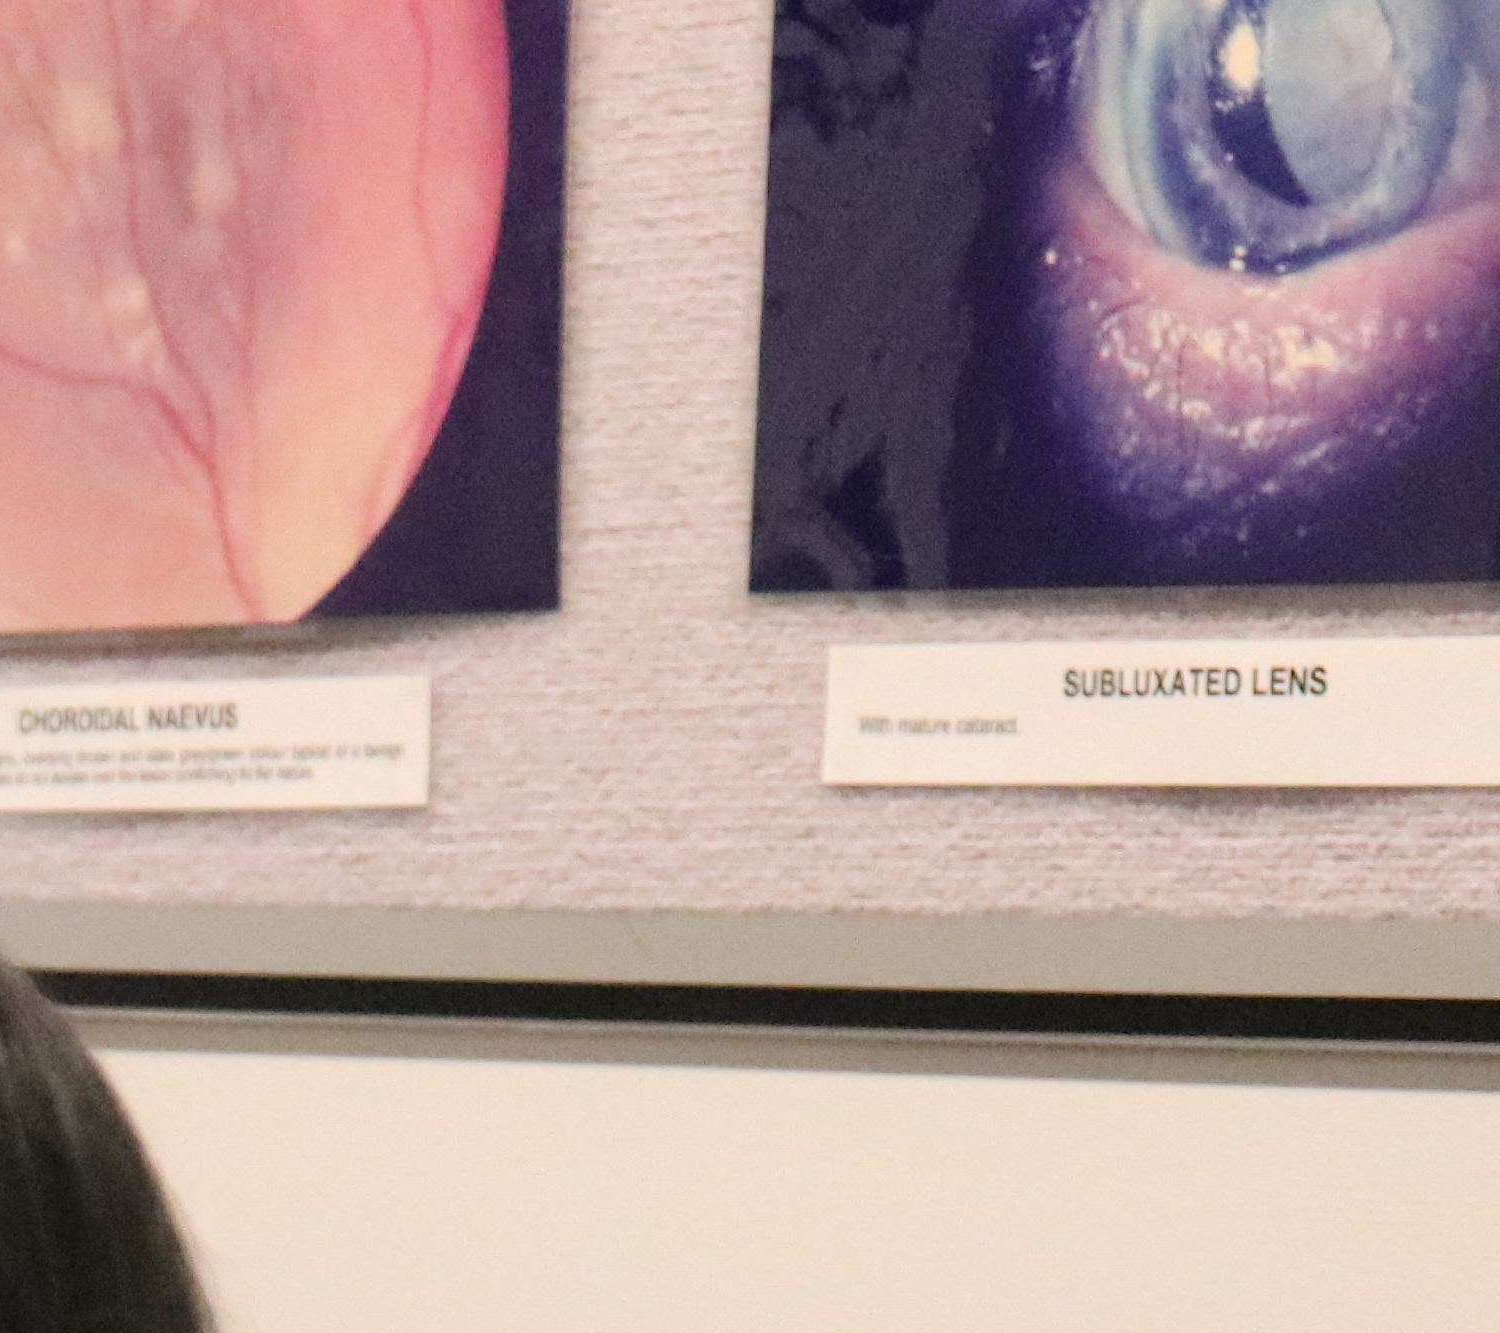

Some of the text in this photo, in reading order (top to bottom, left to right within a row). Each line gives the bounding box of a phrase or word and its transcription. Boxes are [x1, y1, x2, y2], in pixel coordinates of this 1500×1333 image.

[1062, 664, 1329, 698] SUBLUXATED LENS
[17, 700, 239, 735] CHOROIDAL NAEVUS
